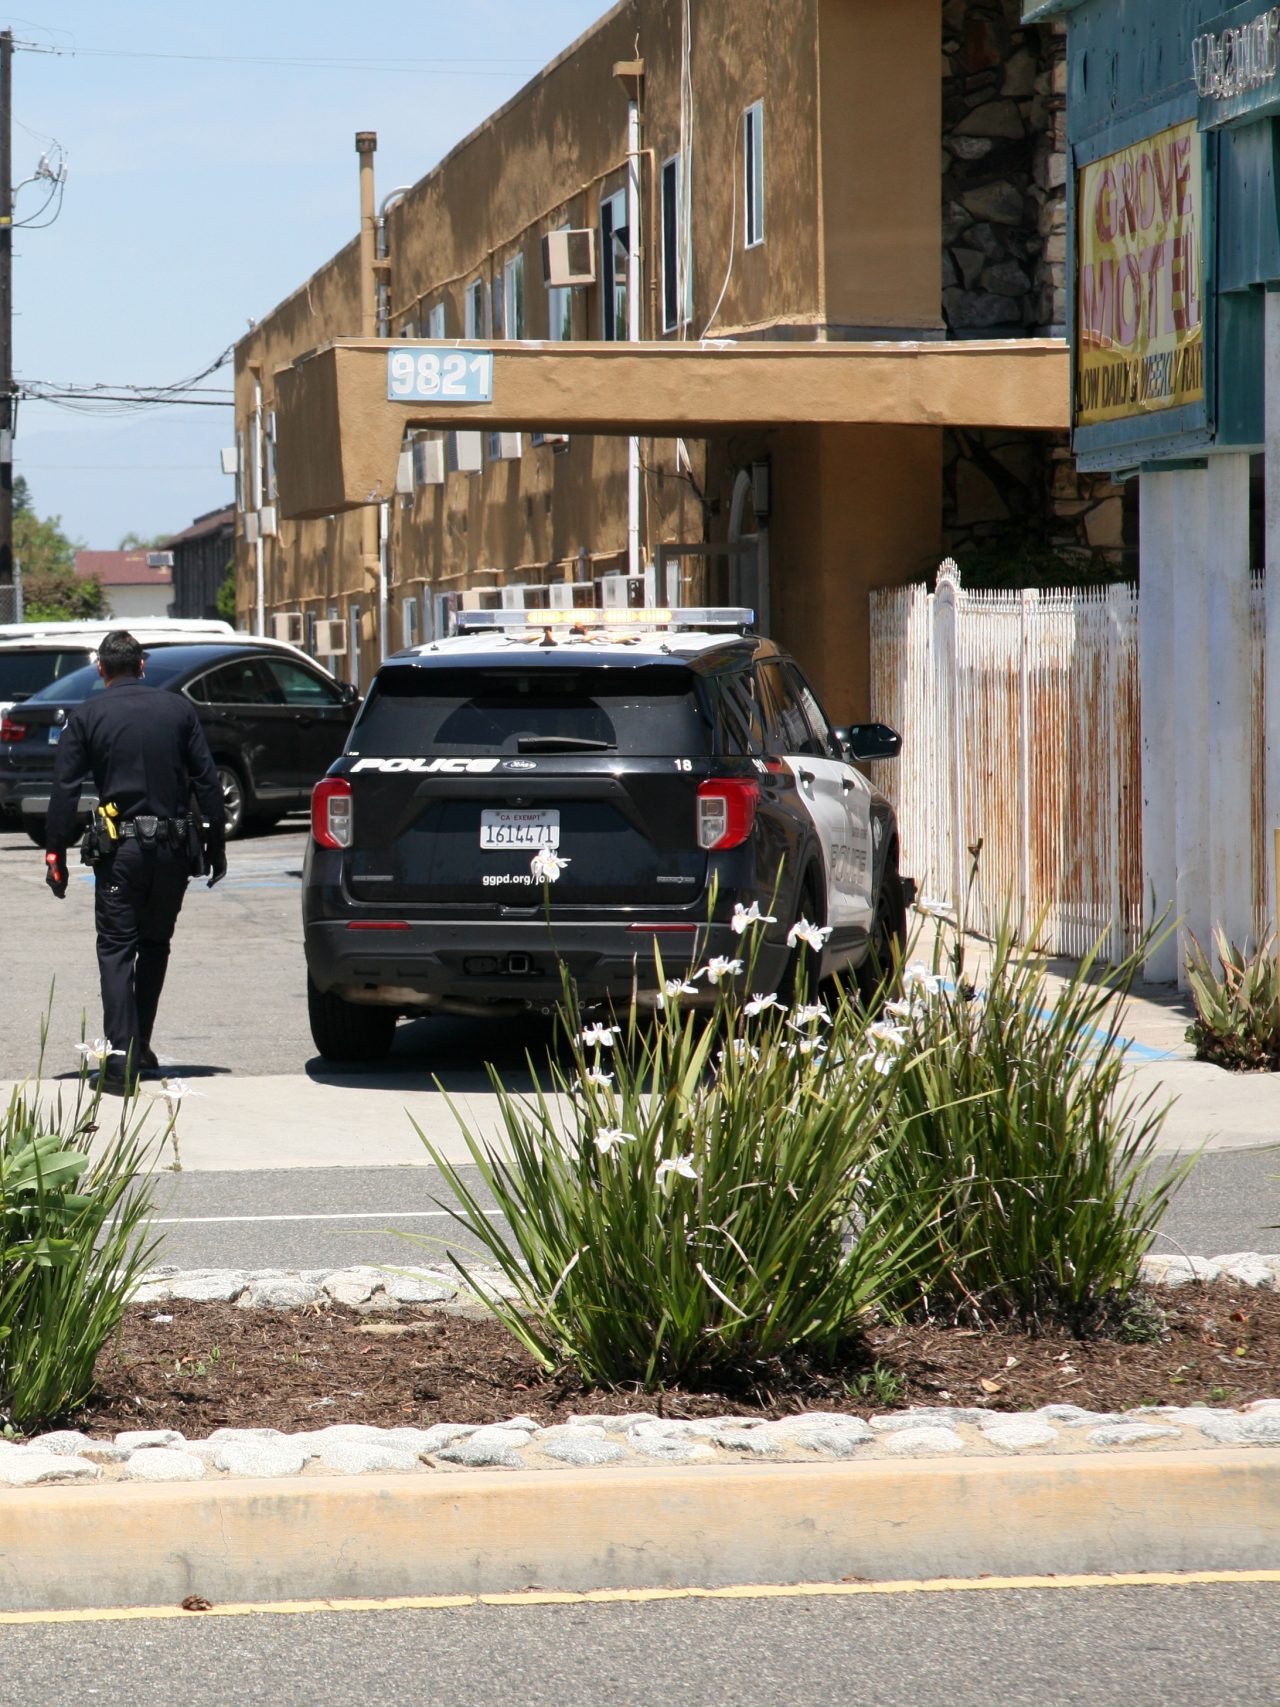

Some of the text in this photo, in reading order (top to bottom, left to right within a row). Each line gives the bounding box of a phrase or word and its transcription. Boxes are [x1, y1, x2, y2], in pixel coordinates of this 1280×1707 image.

[1095, 136, 1192, 242] GROVE
[1082, 231, 1202, 350] MOTEL
[391, 353, 490, 395] 9821
[1102, 360, 1132, 408] DAILY
[1141, 347, 1181, 401] WEEKLY
[350, 758, 501, 773] POLICE
[673, 758, 693, 772] 18
[485, 824, 554, 844] 1614471
[482, 873, 557, 887] ggpd.org/jon
